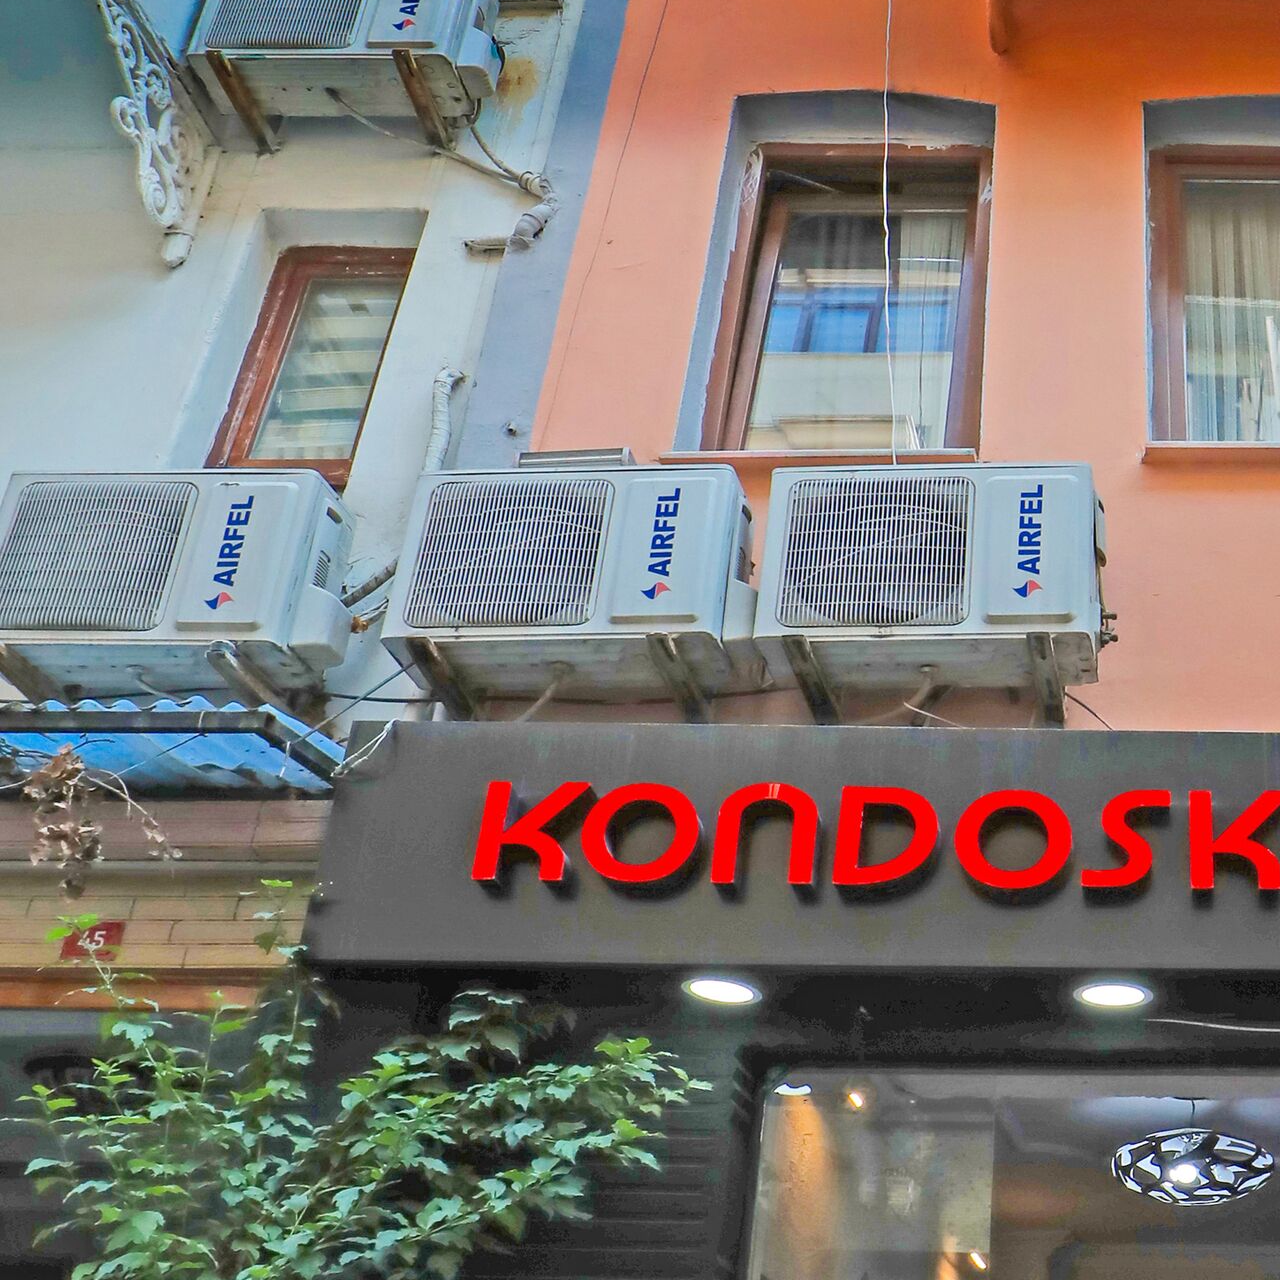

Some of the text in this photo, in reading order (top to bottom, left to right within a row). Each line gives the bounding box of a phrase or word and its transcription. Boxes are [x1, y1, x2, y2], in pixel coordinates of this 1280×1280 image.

[213, 496, 254, 587] AIRFEL
[648, 488, 681, 577] AIRFEL
[1017, 484, 1043, 575] AIRFEL
[77, 930, 106, 949] 45
